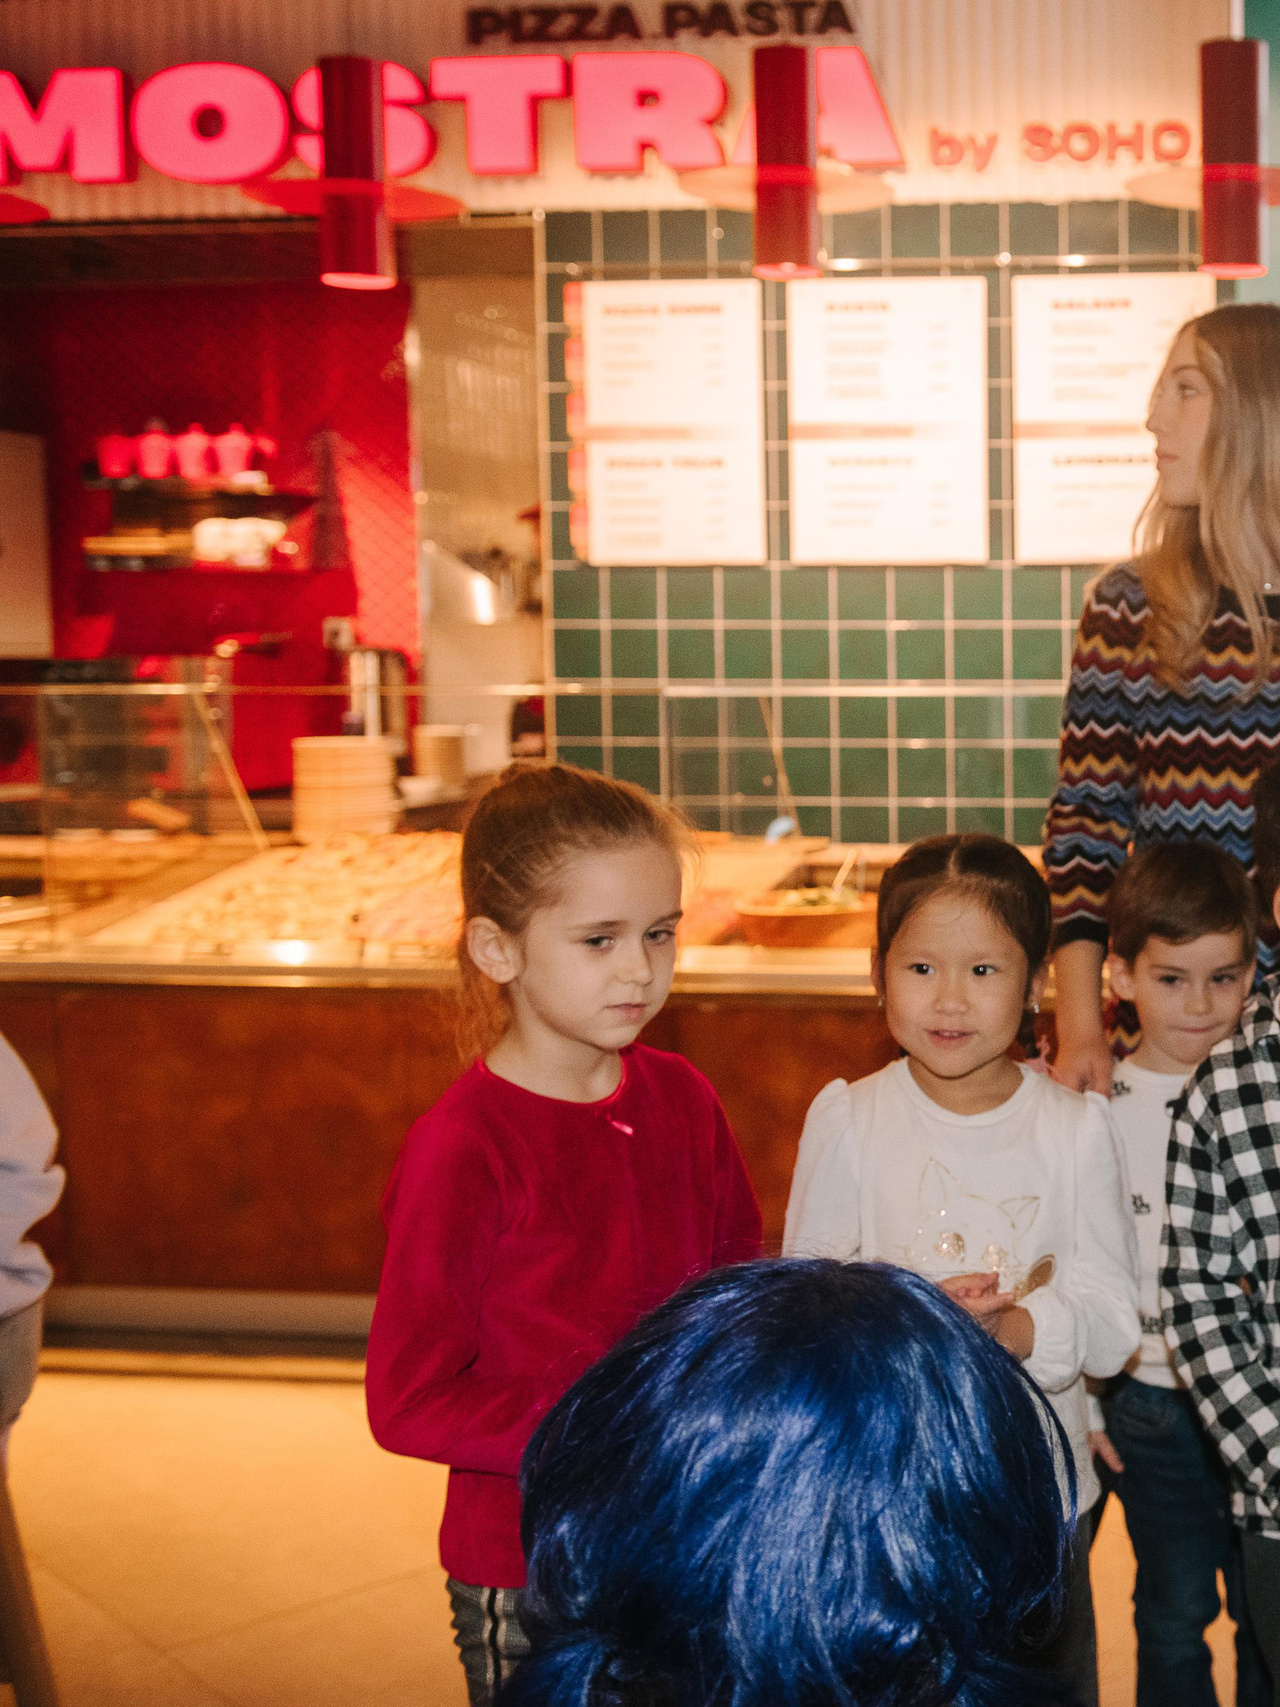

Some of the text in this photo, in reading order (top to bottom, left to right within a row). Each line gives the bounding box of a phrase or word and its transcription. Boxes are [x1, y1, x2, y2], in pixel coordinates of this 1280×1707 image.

[467, 0, 855, 46] PIZZA PASTA
[929, 121, 1191, 173] by SOHO
